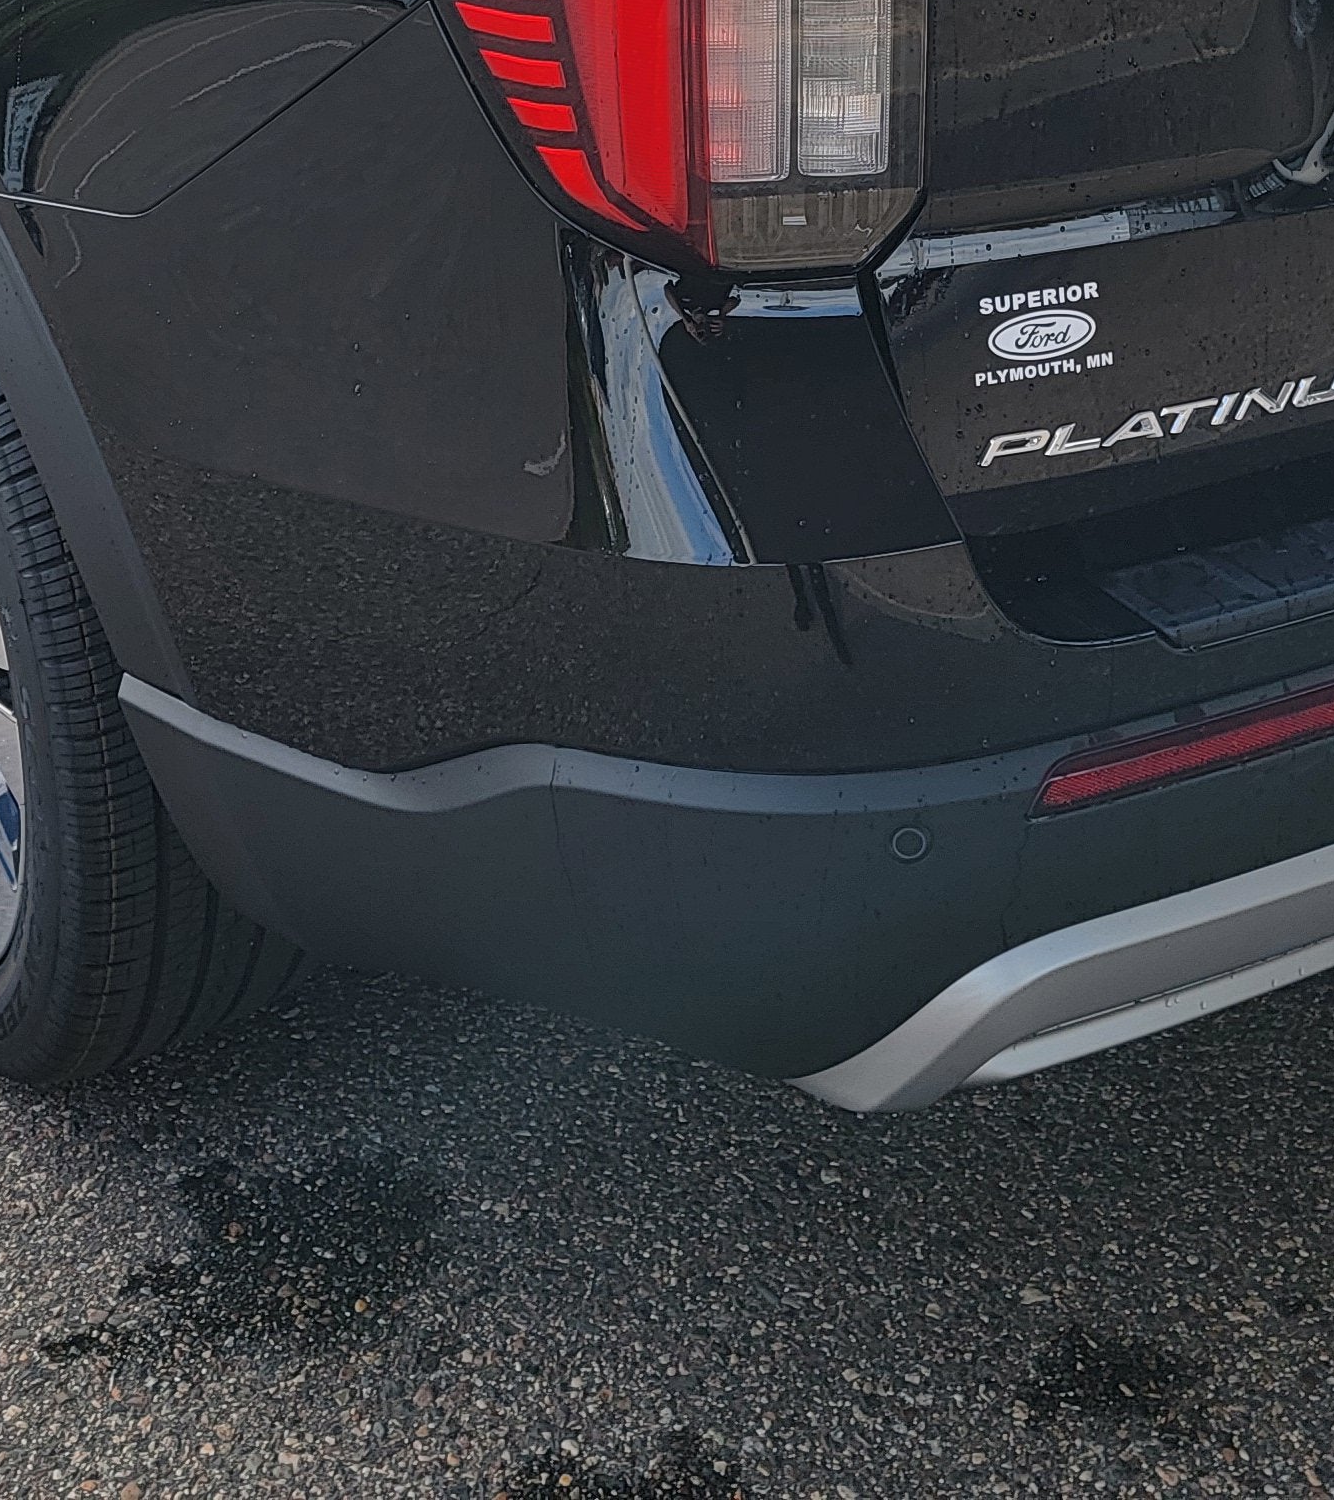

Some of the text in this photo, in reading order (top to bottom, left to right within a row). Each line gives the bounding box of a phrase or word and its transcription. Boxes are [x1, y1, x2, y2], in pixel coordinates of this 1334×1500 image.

[979, 281, 1099, 316] SUPERIOR
[1014, 321, 1072, 351] Ford
[974, 351, 1114, 387] PLYMOUTH, MN
